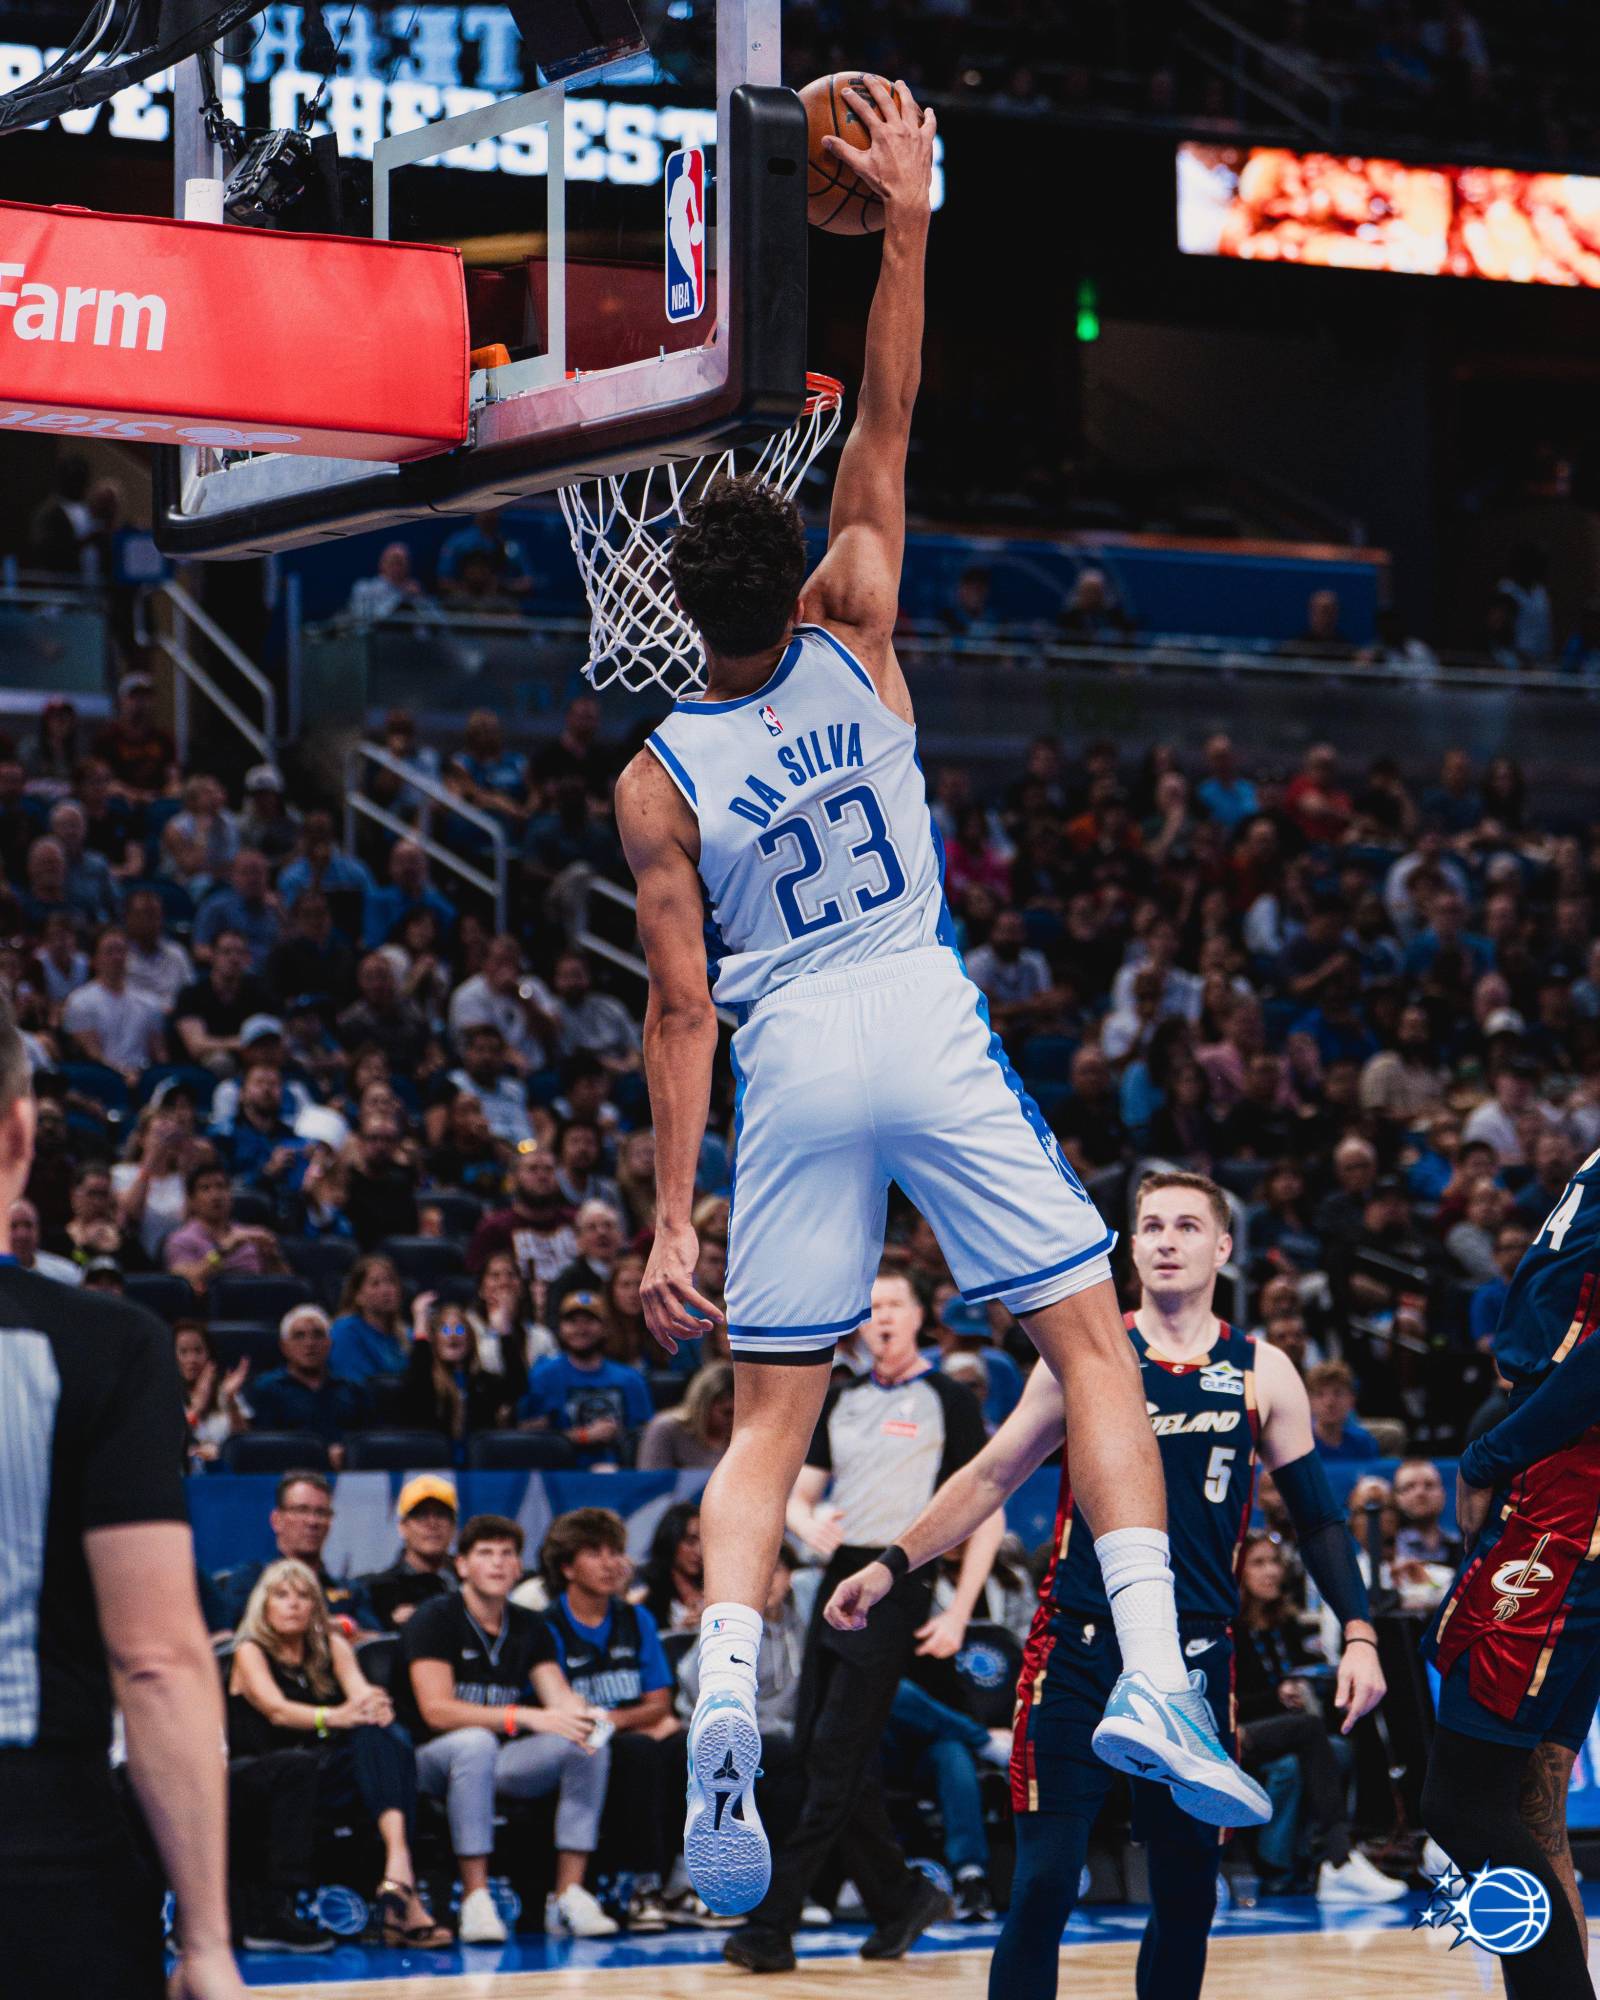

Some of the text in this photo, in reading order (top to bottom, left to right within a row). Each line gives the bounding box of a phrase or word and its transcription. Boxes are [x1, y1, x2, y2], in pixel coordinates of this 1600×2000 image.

[671, 281, 690, 311] NBA
[728, 722, 864, 829] DA SILVA
[754, 779, 910, 942] 23
[1204, 1446, 1237, 1504] 5
